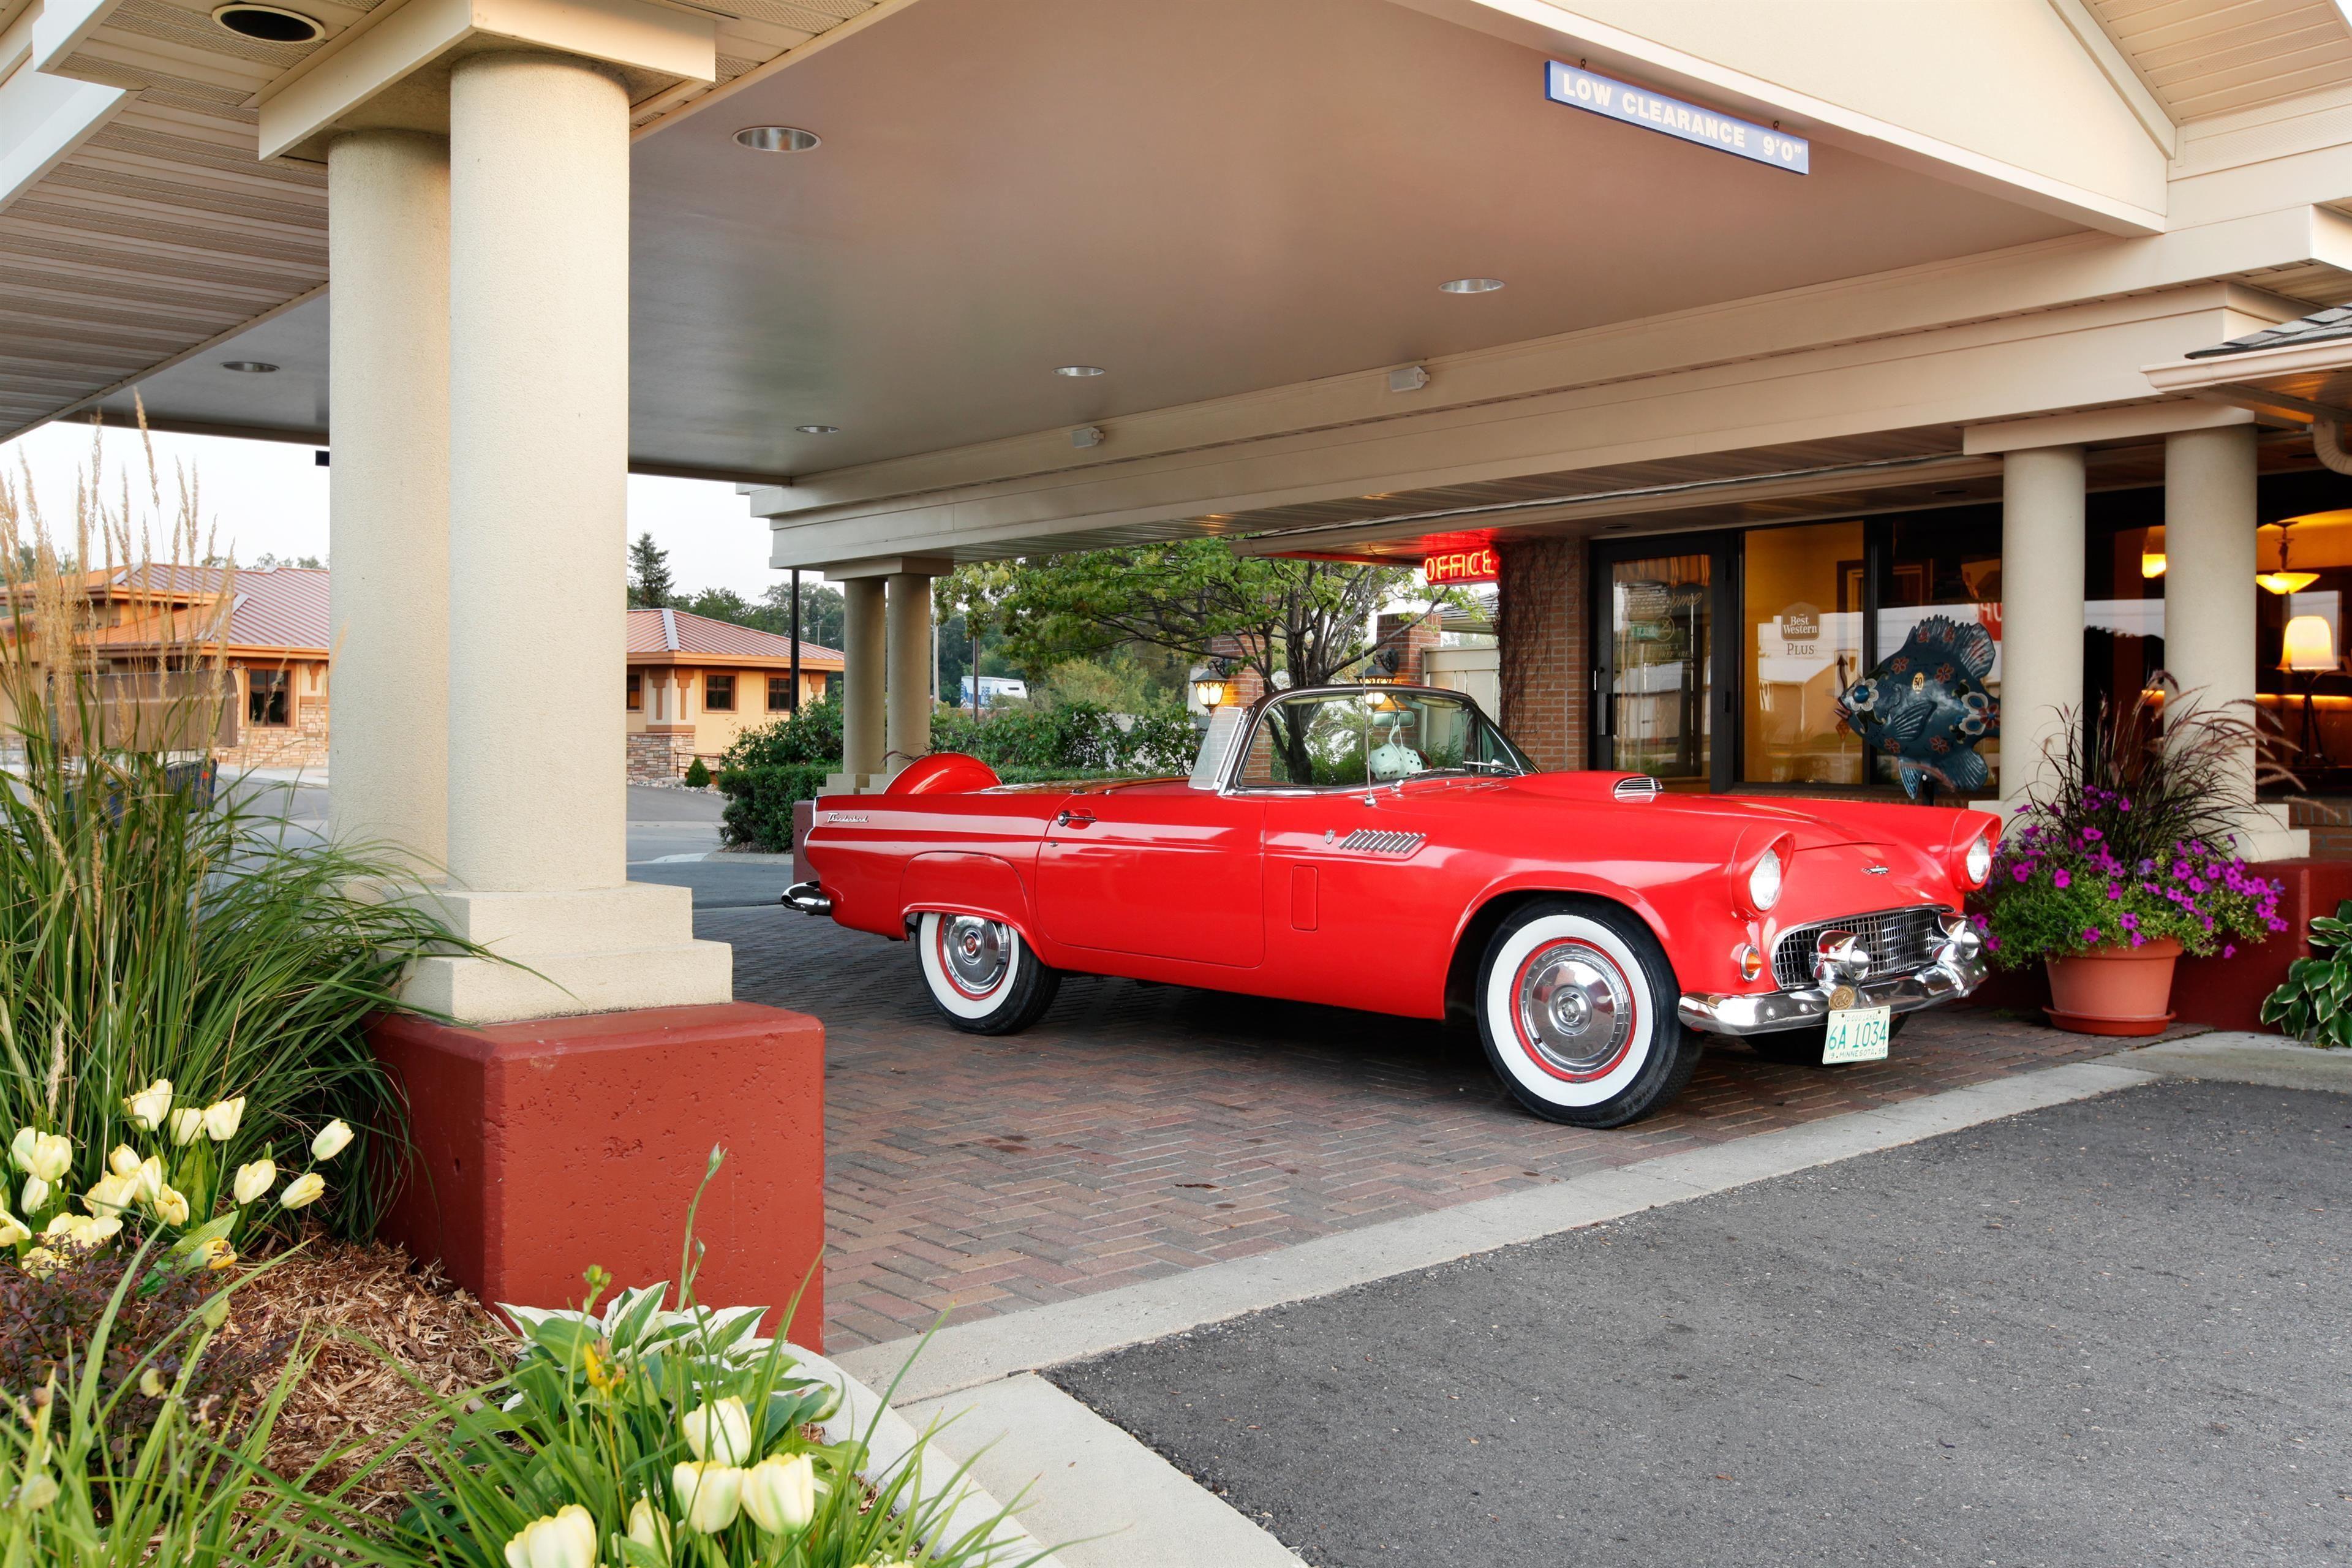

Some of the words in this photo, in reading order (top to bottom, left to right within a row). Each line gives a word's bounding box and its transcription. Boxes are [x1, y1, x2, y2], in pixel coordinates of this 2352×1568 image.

[1563, 73, 1612, 107] LOW
[1622, 92, 1746, 148] CLEARANCE
[1425, 549, 1495, 581] OFFICE
[1790, 616, 1809, 625] Best
[1783, 624, 1817, 634] Western
[1787, 643, 1814, 655] PLUS
[1914, 677, 1923, 688] 50
[827, 812, 869, 823] Thunderbird
[1828, 1023, 1846, 1050] 6A
[1852, 1019, 1887, 1048] 1034
[1839, 1049, 1874, 1058] MINNESOTA
